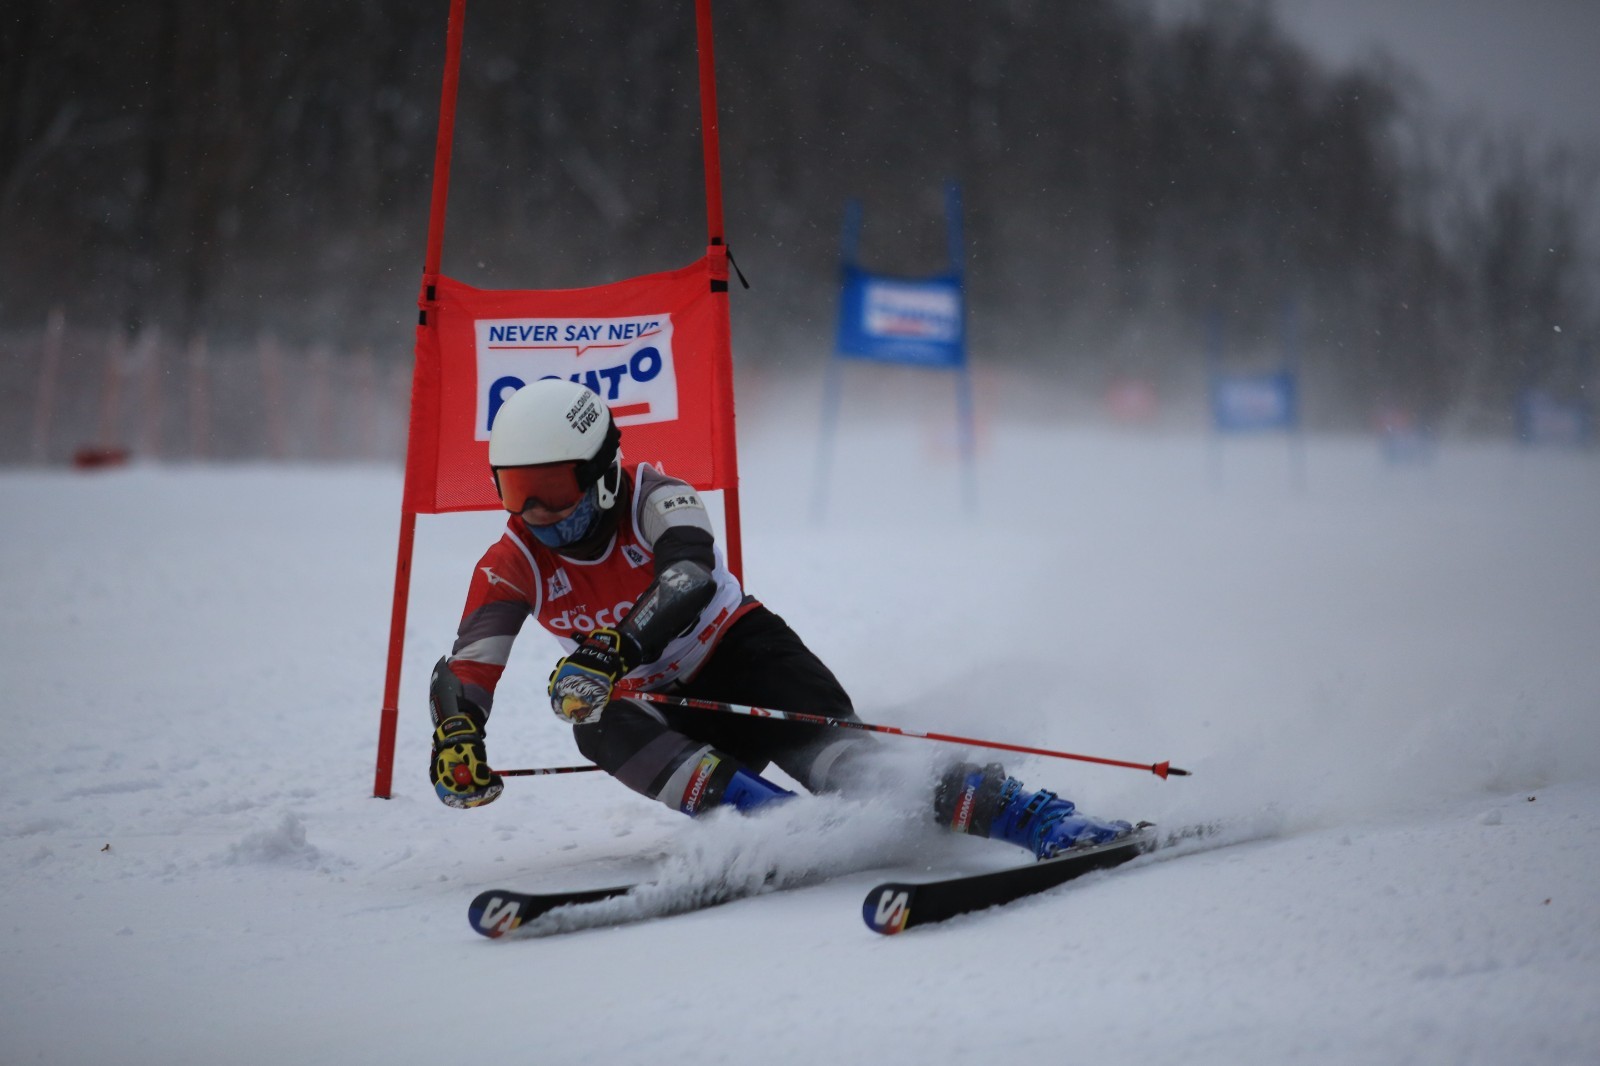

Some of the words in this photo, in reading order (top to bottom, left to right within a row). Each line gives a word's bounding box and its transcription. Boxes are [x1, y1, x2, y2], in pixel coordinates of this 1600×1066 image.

[489, 325, 559, 342] NEVER
[564, 325, 602, 342] SAY
[566, 390, 593, 421] SALOMO
[576, 407, 600, 434] uvex
[549, 595, 640, 632] doco
[568, 603, 587, 616] NTT
[575, 647, 610, 664] LEVEL
[686, 763, 707, 813] SALOMO
